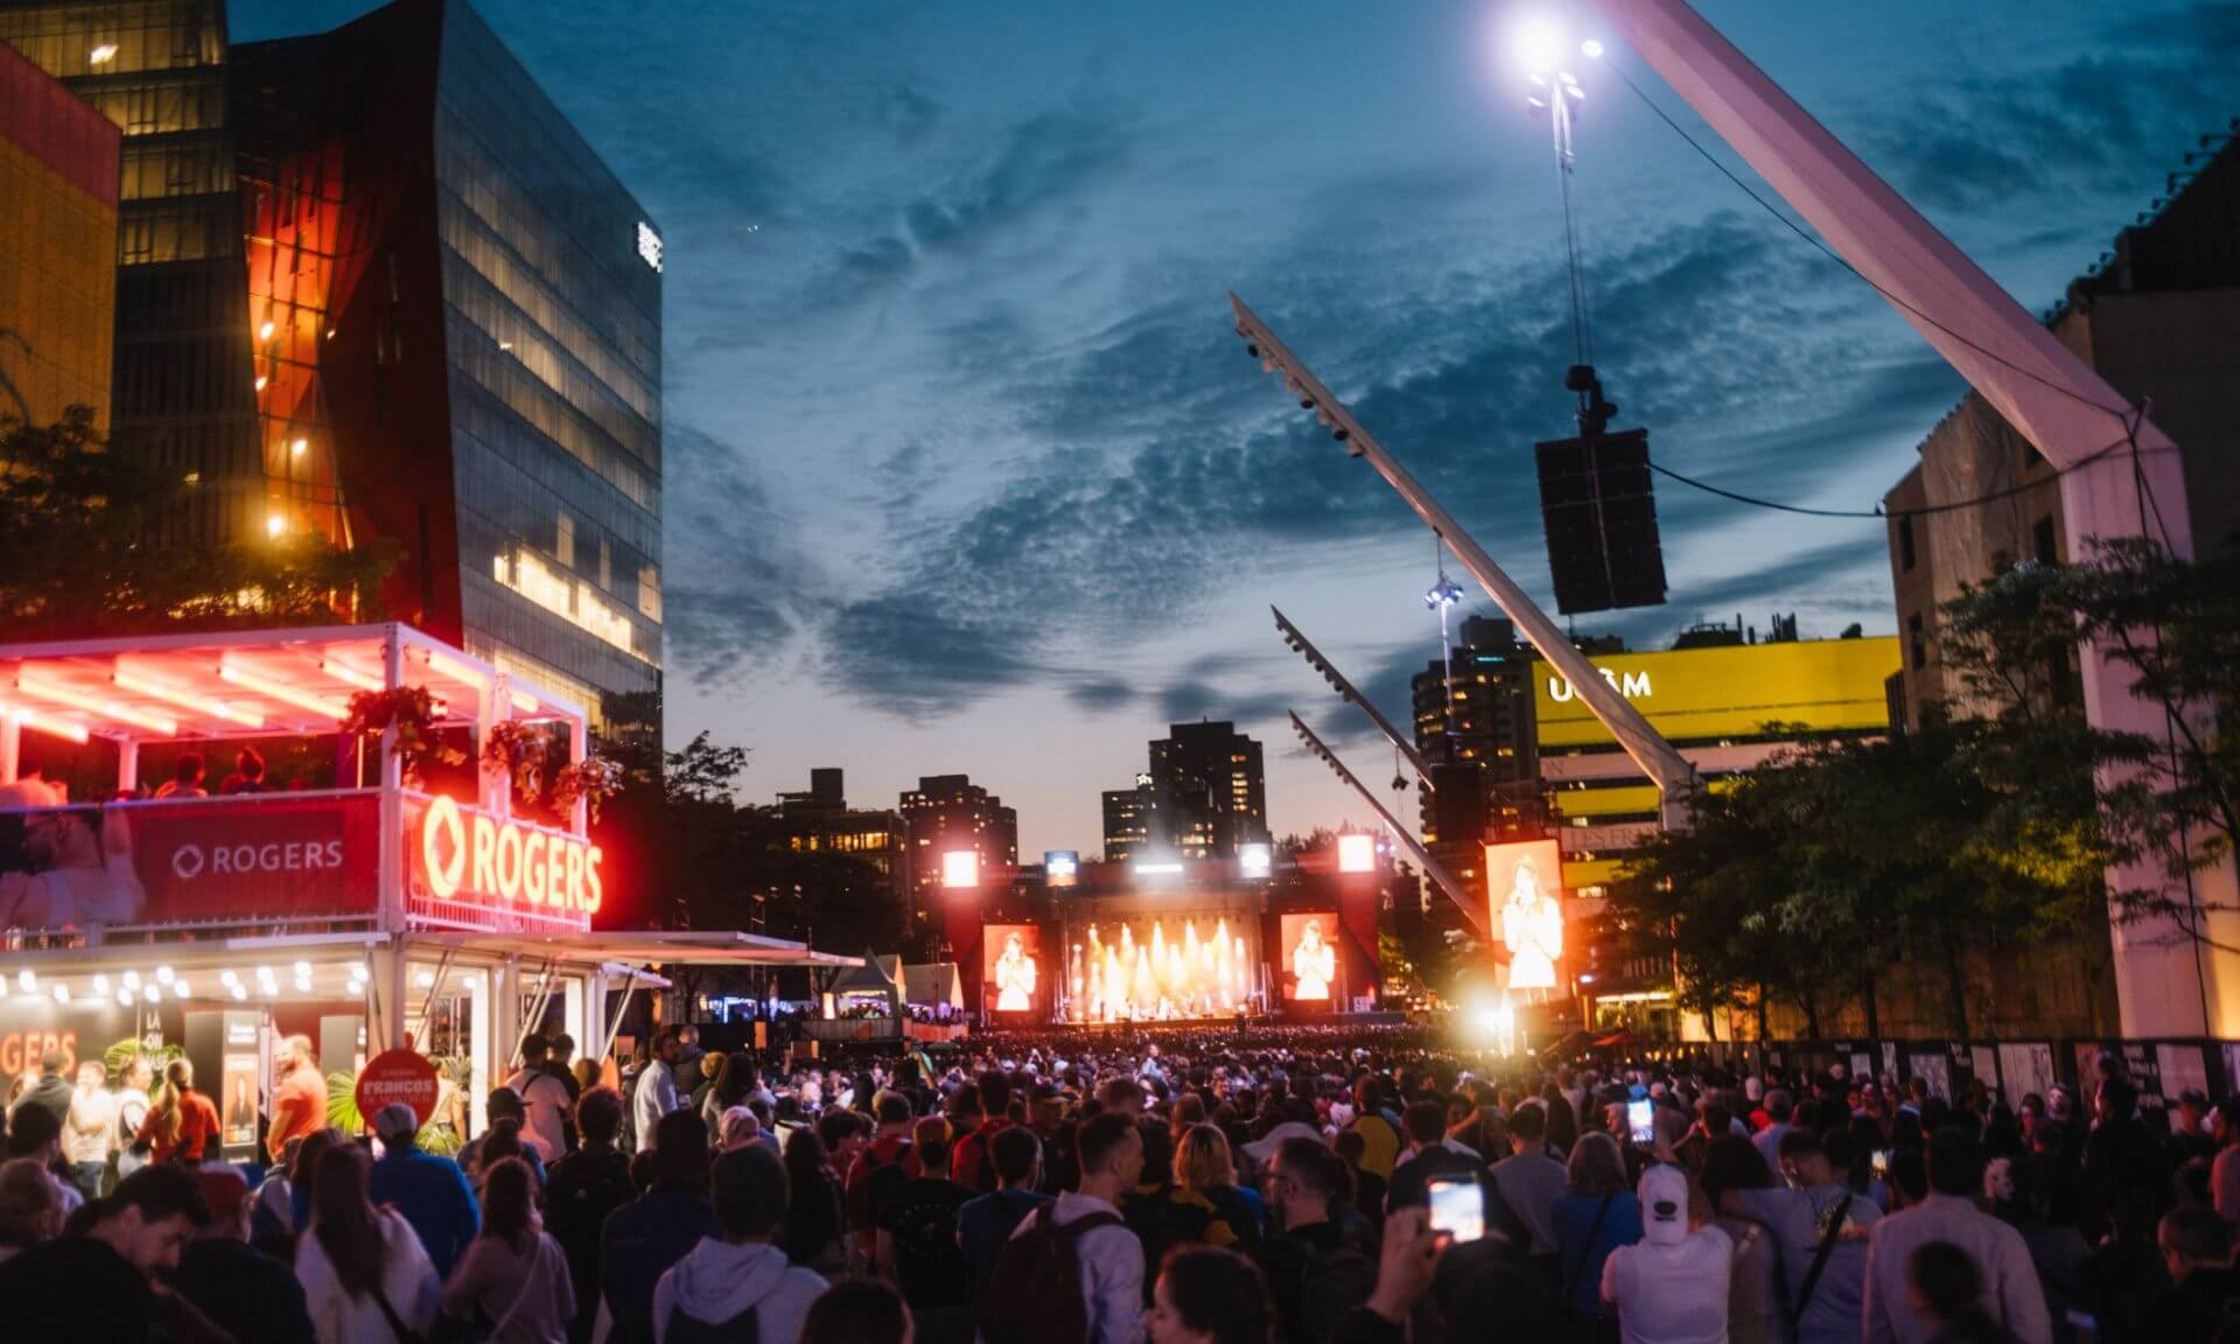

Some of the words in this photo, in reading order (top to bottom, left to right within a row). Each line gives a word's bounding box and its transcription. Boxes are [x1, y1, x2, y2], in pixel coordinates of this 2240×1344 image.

[1549, 667, 1652, 701] UM
[212, 841, 343, 873] ROGERS
[474, 815, 603, 914] ROGERS
[363, 1080, 433, 1095] FRANCOS
